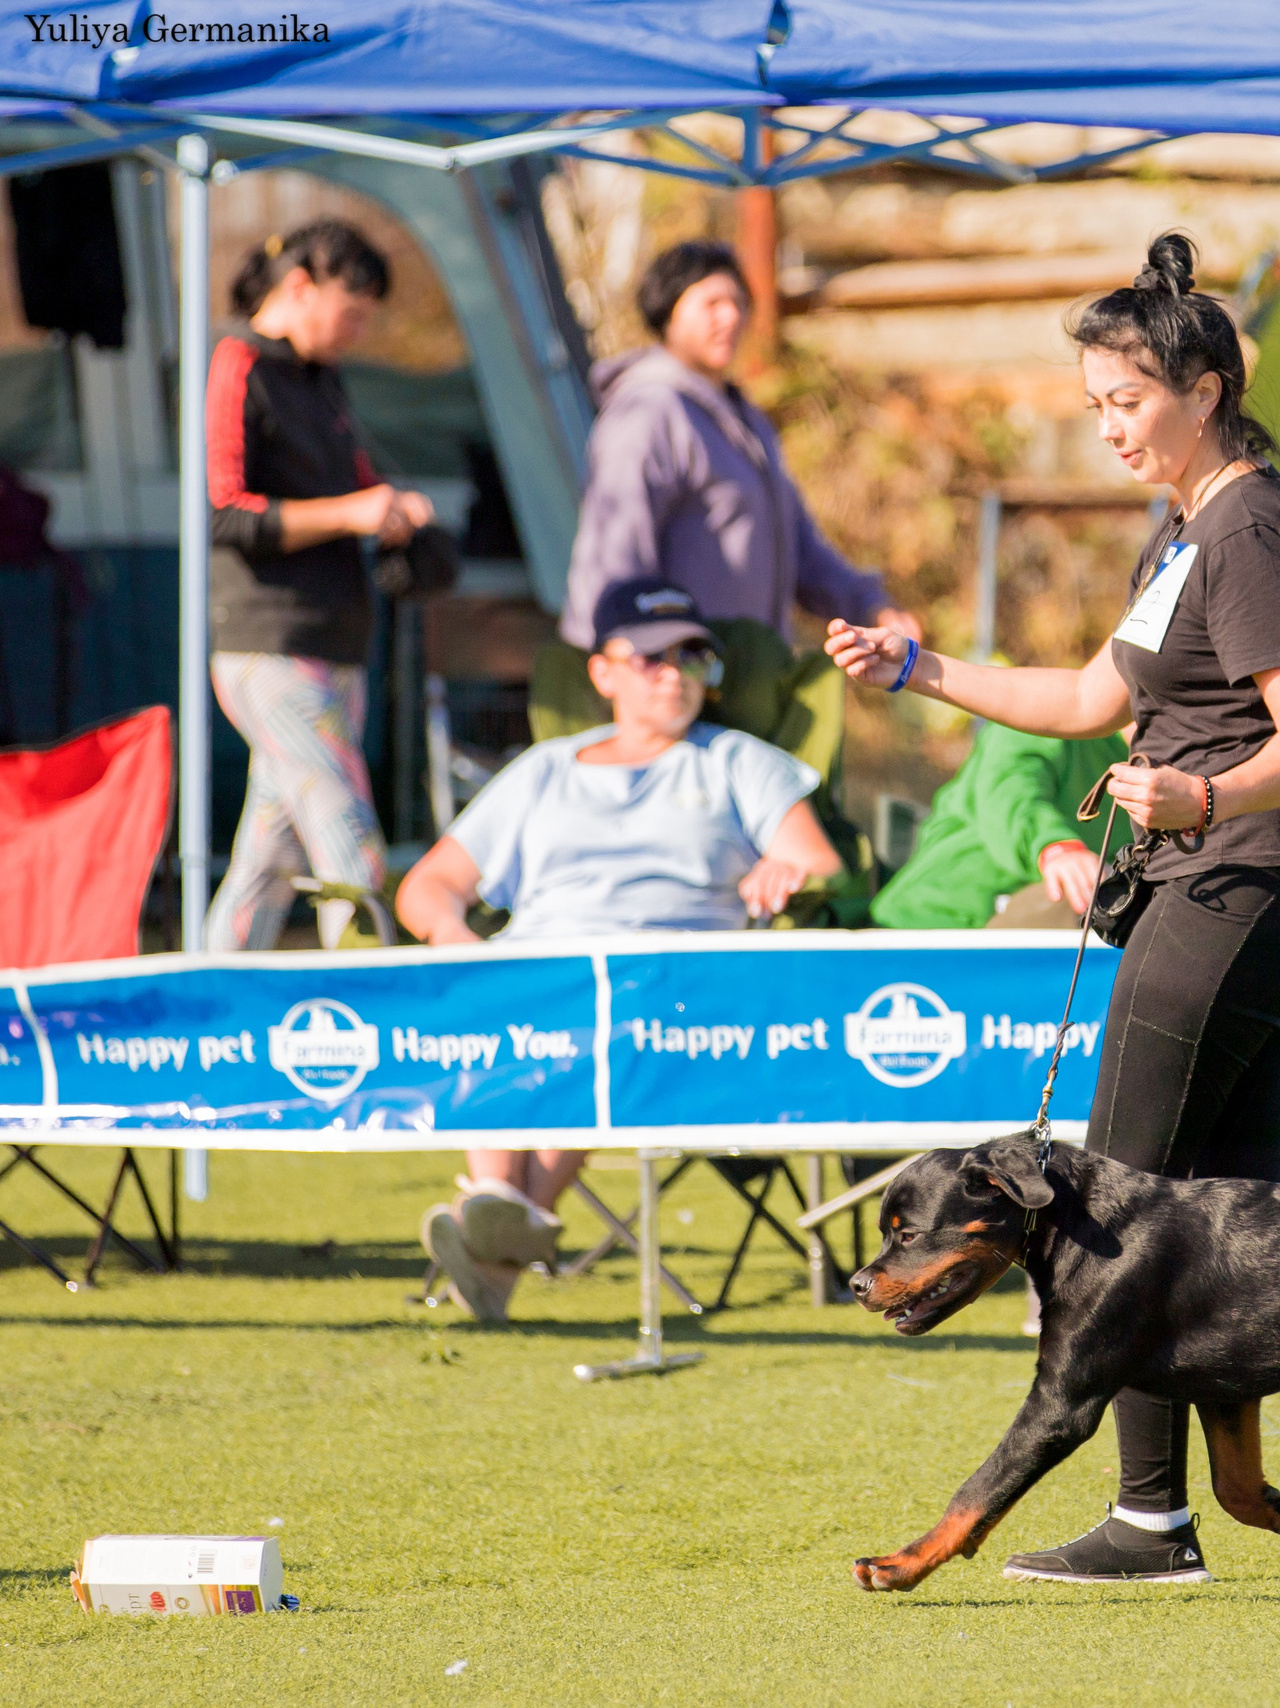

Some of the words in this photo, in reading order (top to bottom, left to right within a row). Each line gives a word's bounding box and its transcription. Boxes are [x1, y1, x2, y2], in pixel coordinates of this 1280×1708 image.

[77, 1031, 189, 1072] Happy
[199, 1030, 256, 1072] pet
[391, 1026, 501, 1071] Happy
[506, 1023, 579, 1060] You.
[632, 1017, 754, 1060] Happy
[766, 1017, 829, 1060] pet
[982, 1013, 1102, 1058] Happy
